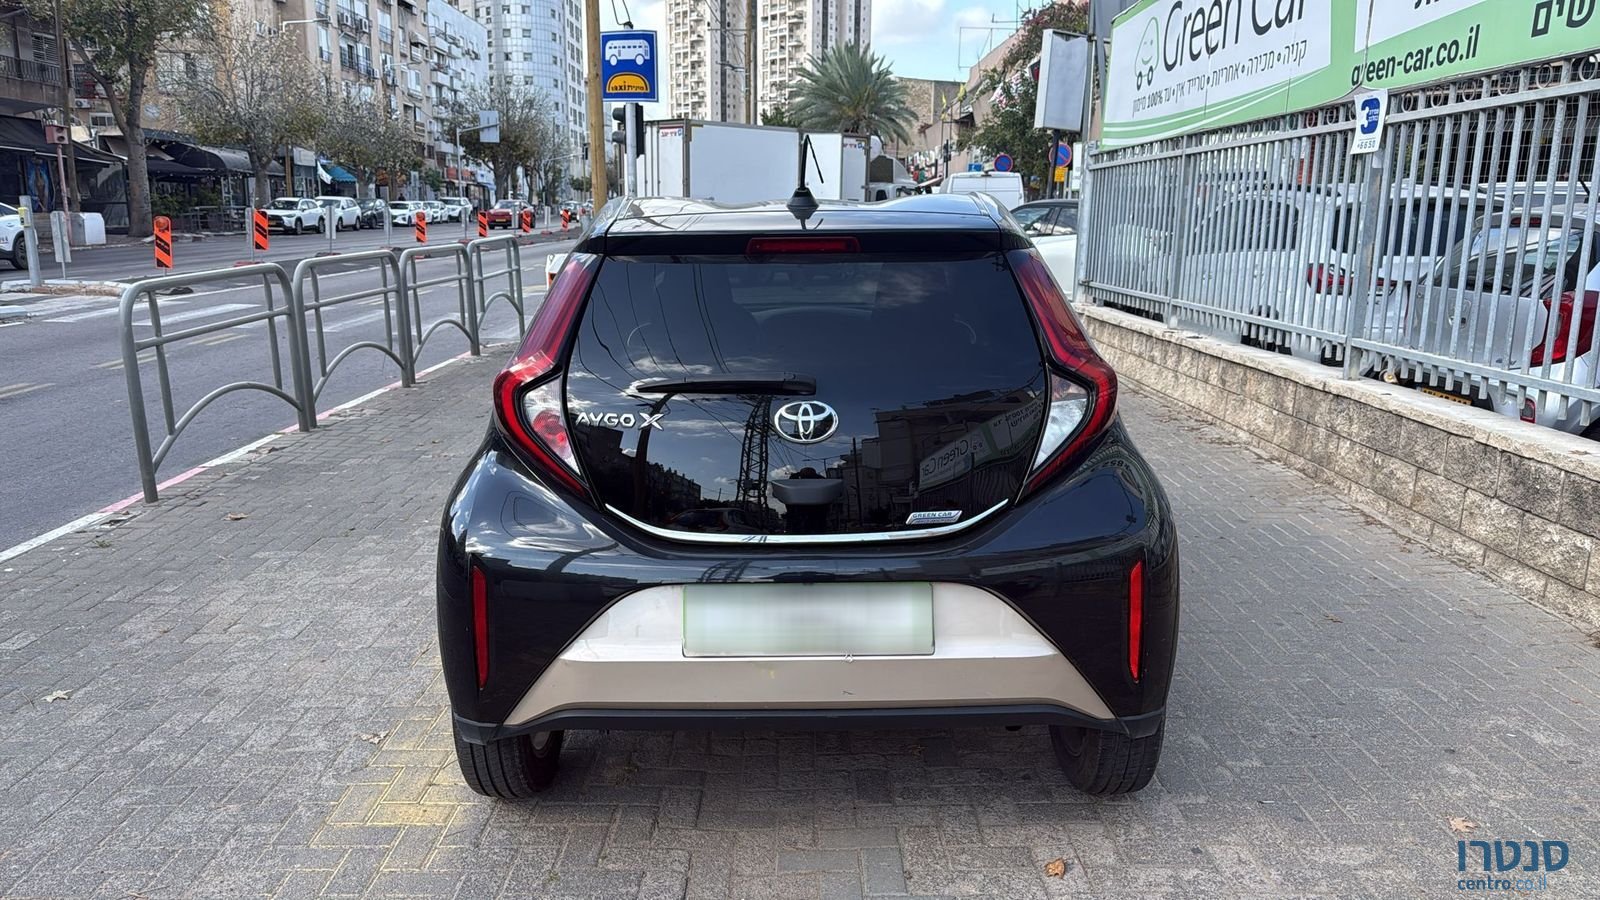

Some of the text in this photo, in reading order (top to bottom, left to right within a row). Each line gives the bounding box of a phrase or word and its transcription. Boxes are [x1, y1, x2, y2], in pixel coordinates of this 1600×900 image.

[1163, 0, 1242, 73] Green
[1246, 50, 1275, 77] מכירה
[1282, 40, 1308, 68] קניה
[1210, 61, 1241, 88] אחריות
[575, 411, 664, 431] AYGO X
